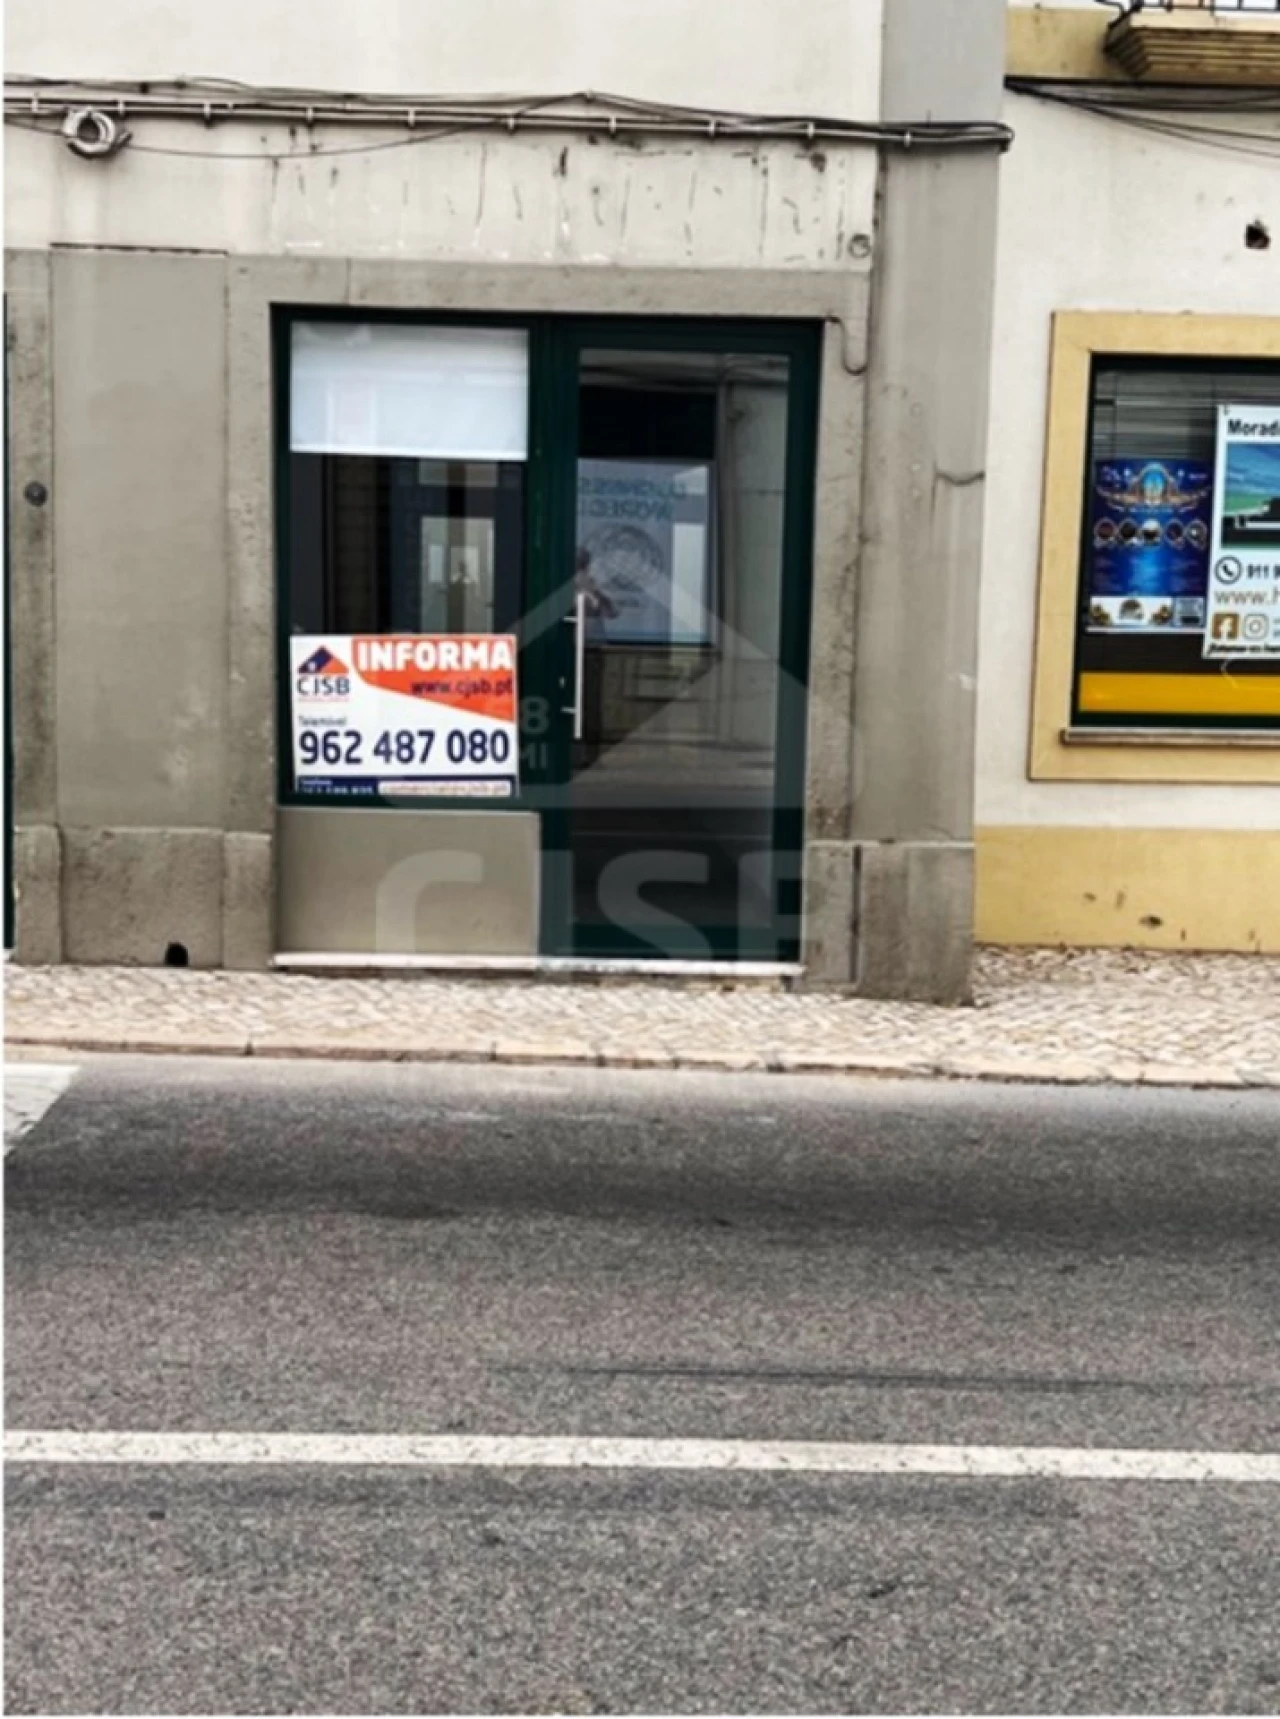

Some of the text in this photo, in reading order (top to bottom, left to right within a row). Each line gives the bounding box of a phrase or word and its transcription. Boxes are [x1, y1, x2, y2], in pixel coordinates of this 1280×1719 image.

[357, 640, 513, 672] INFORMA
[410, 677, 513, 700] www.cjsb.pt
[299, 729, 510, 765] 962 487 080
